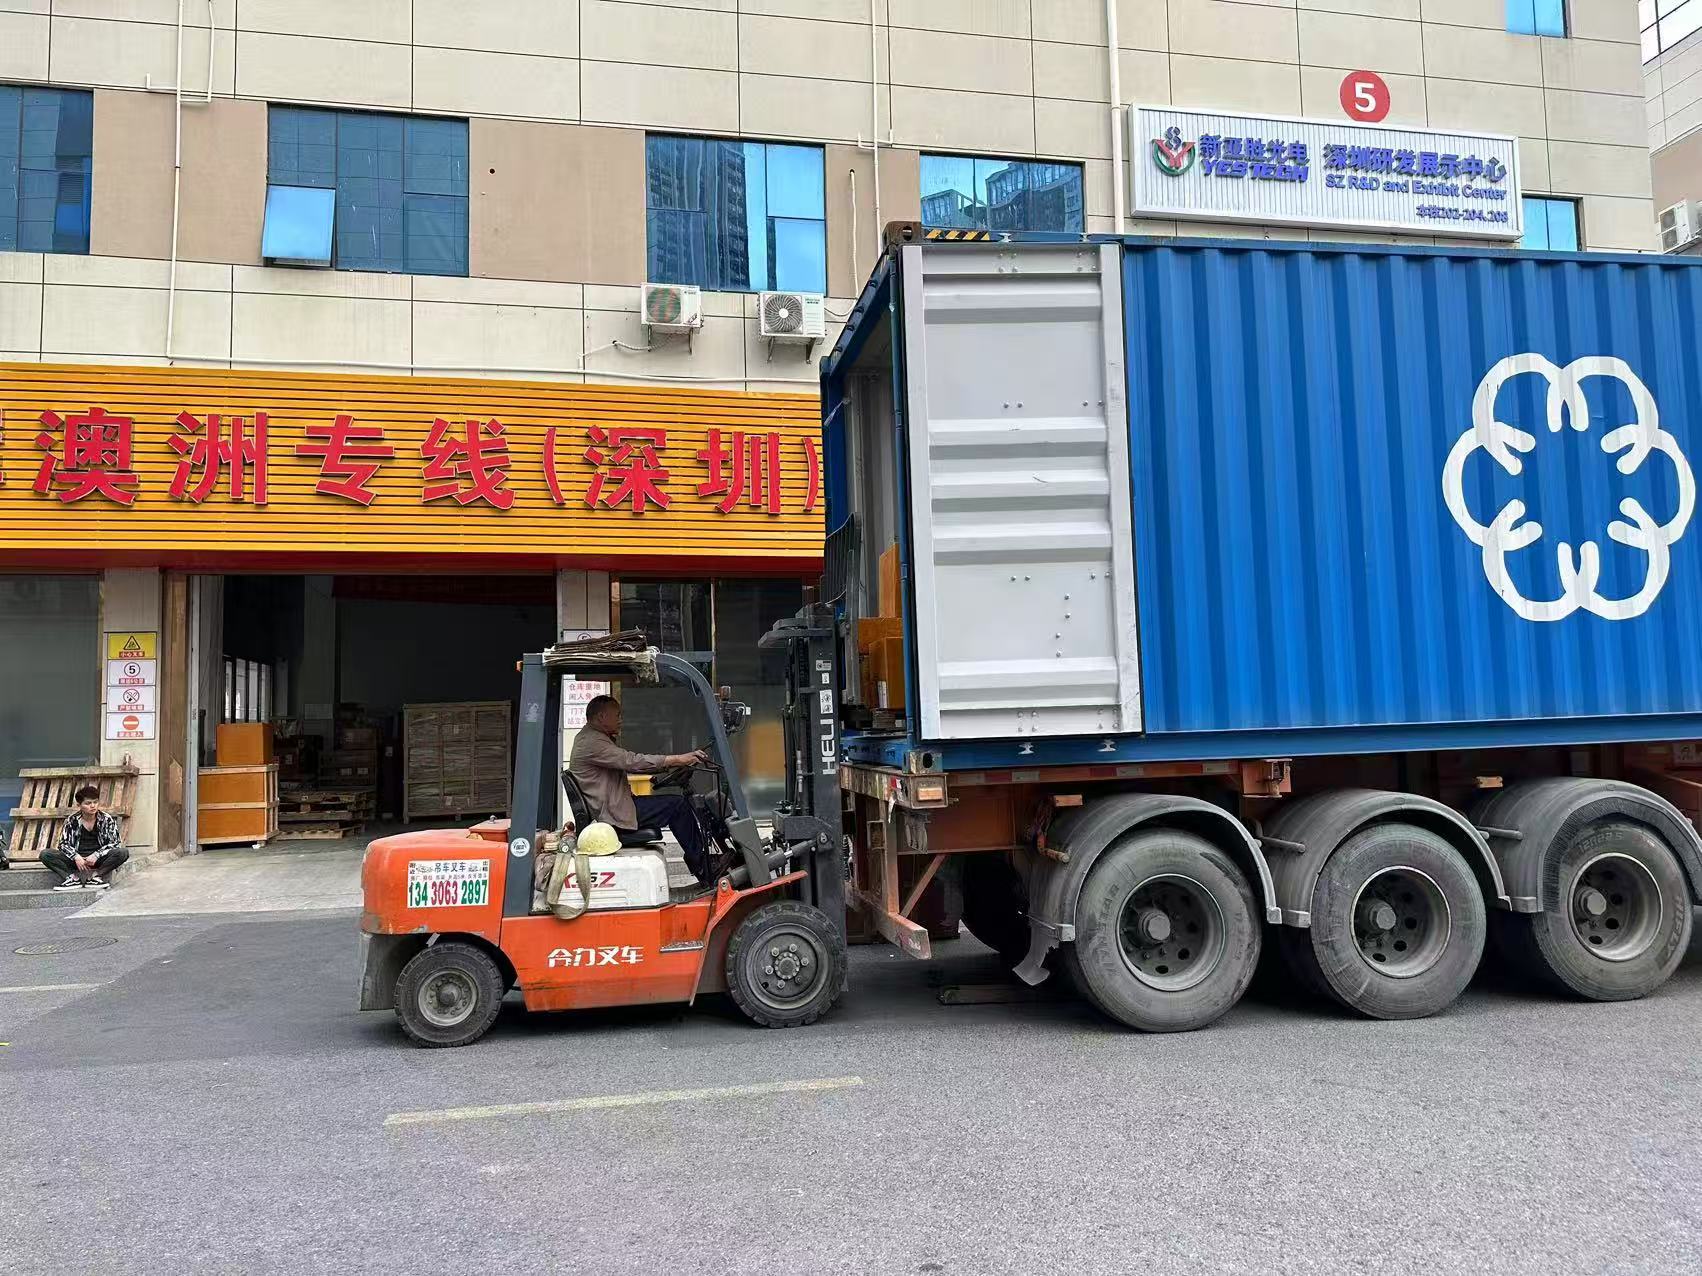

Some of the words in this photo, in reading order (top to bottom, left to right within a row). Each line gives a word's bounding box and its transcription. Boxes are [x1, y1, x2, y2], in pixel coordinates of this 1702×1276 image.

[1354, 82, 1377, 112] 5
[1199, 133, 1311, 166] 新亚胜光电
[1323, 143, 1507, 183] 深圳研发展示中心
[1325, 174, 1346, 188] SZ
[1348, 175, 1380, 191] R&D
[1383, 179, 1409, 194] and
[1412, 180, 1460, 198] Exhibit
[1462, 184, 1507, 200] Center
[0, 405, 820, 515] 澳洲专线（深圳）
[129, 665, 136, 675] 5
[820, 718, 837, 775] HELI
[434, 861, 466, 873] 吊车叉车
[408, 881, 429, 907] 134
[431, 880, 459, 906] 3063
[460, 879, 488, 905] 2897
[547, 946, 644, 968] 合力叉车
